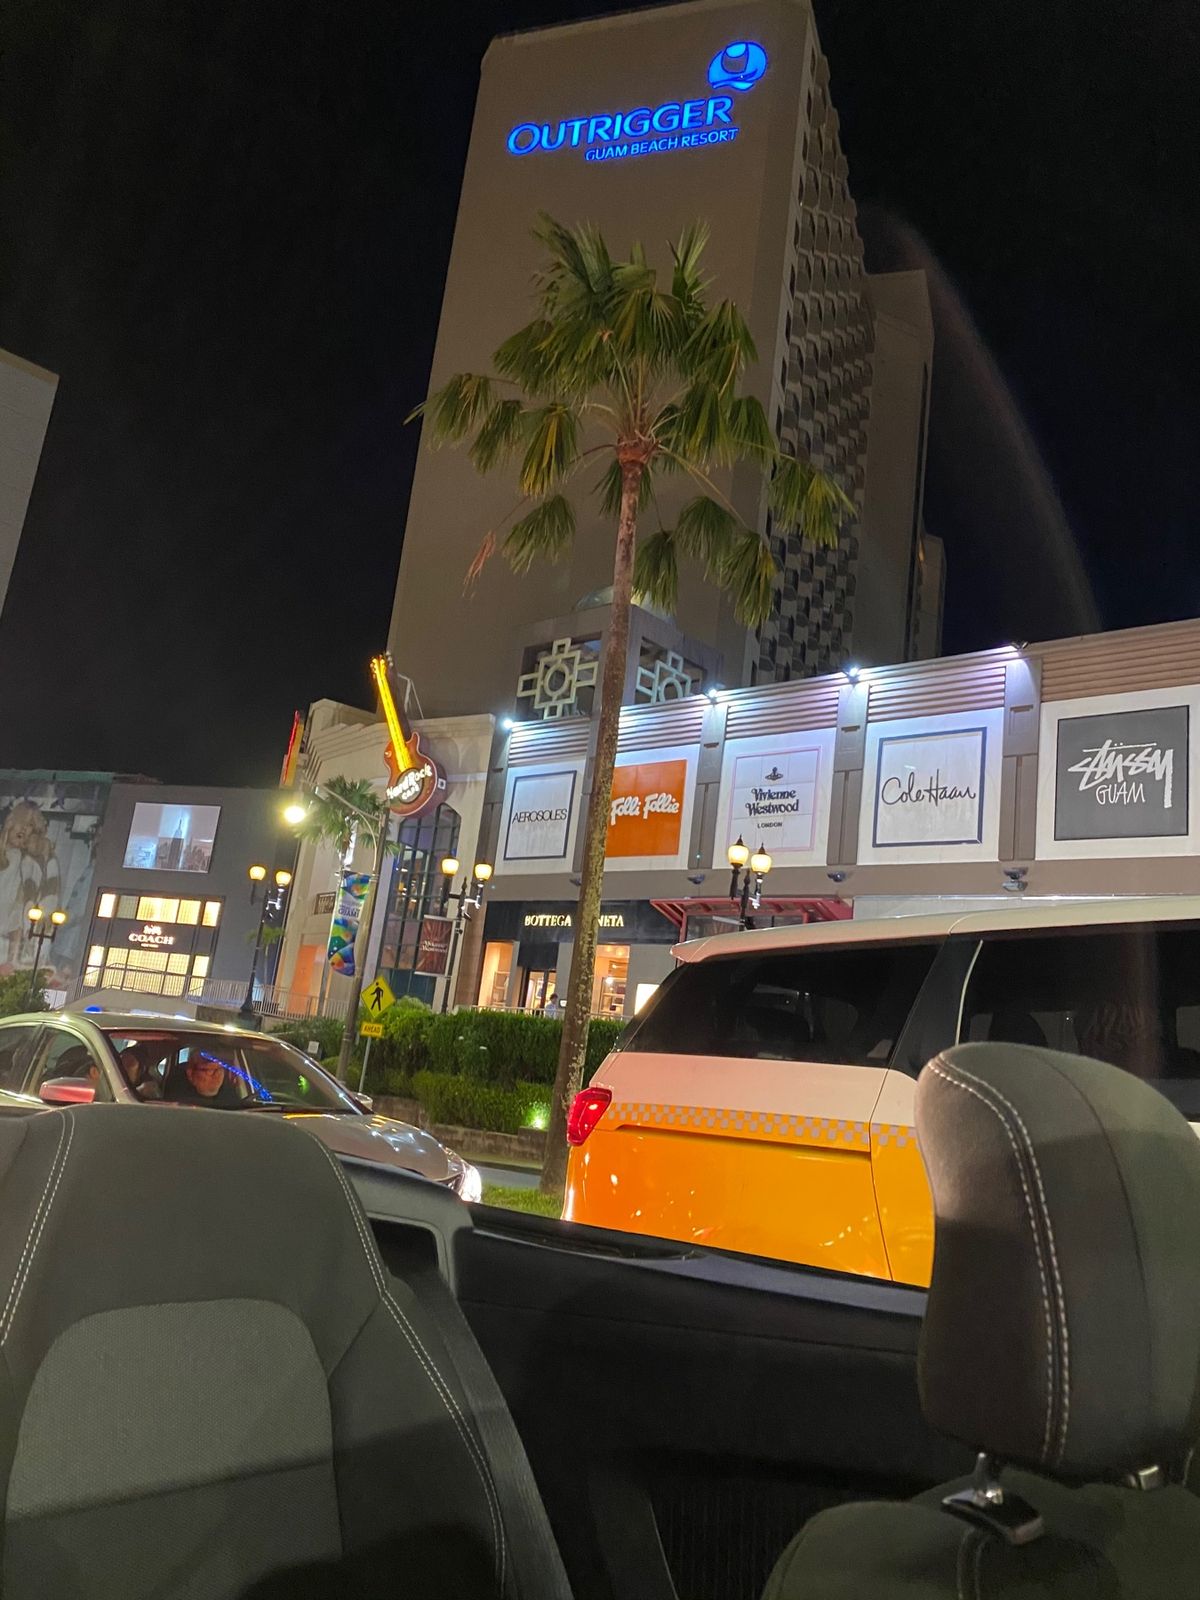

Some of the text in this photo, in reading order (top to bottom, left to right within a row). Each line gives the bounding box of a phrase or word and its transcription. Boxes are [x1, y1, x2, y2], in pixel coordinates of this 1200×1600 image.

[507, 96, 733, 155] OUTRIGGER
[585, 128, 738, 161] GUAM BEACH RESORT
[407, 762, 432, 787] Rock
[751, 787, 796, 802] Vivienne
[881, 769, 976, 806] Cole Haan
[1096, 781, 1146, 805] GUAM
[512, 808, 568, 824] AEROSOLES
[610, 792, 680, 826] Folli Follie
[745, 799, 799, 817] Westwood
[524, 914, 572, 927] BOTTEGA
[128, 933, 174, 945] COACH
